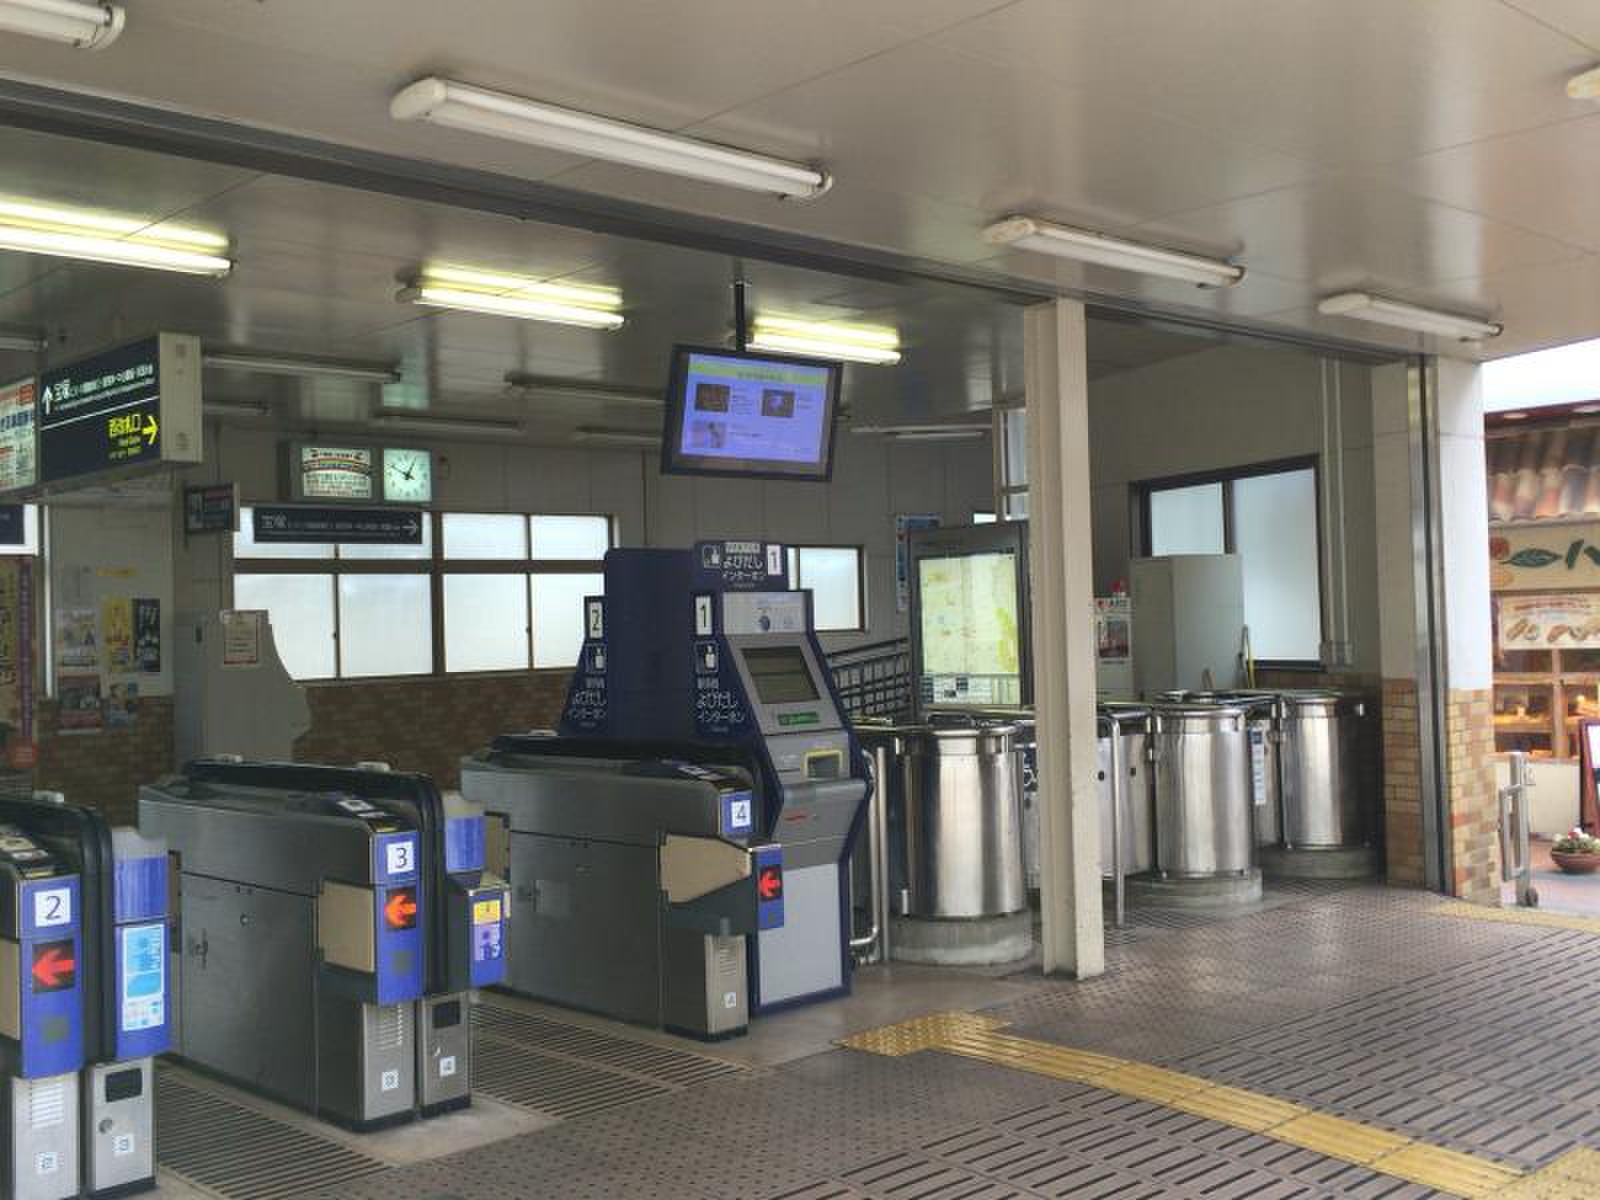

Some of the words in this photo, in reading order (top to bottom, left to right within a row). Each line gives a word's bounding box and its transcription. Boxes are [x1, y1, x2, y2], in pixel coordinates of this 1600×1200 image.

[590, 609, 600, 632] 2
[735, 804, 747, 821] 4
[394, 848, 408, 868] 3
[44, 895, 63, 921] 2
